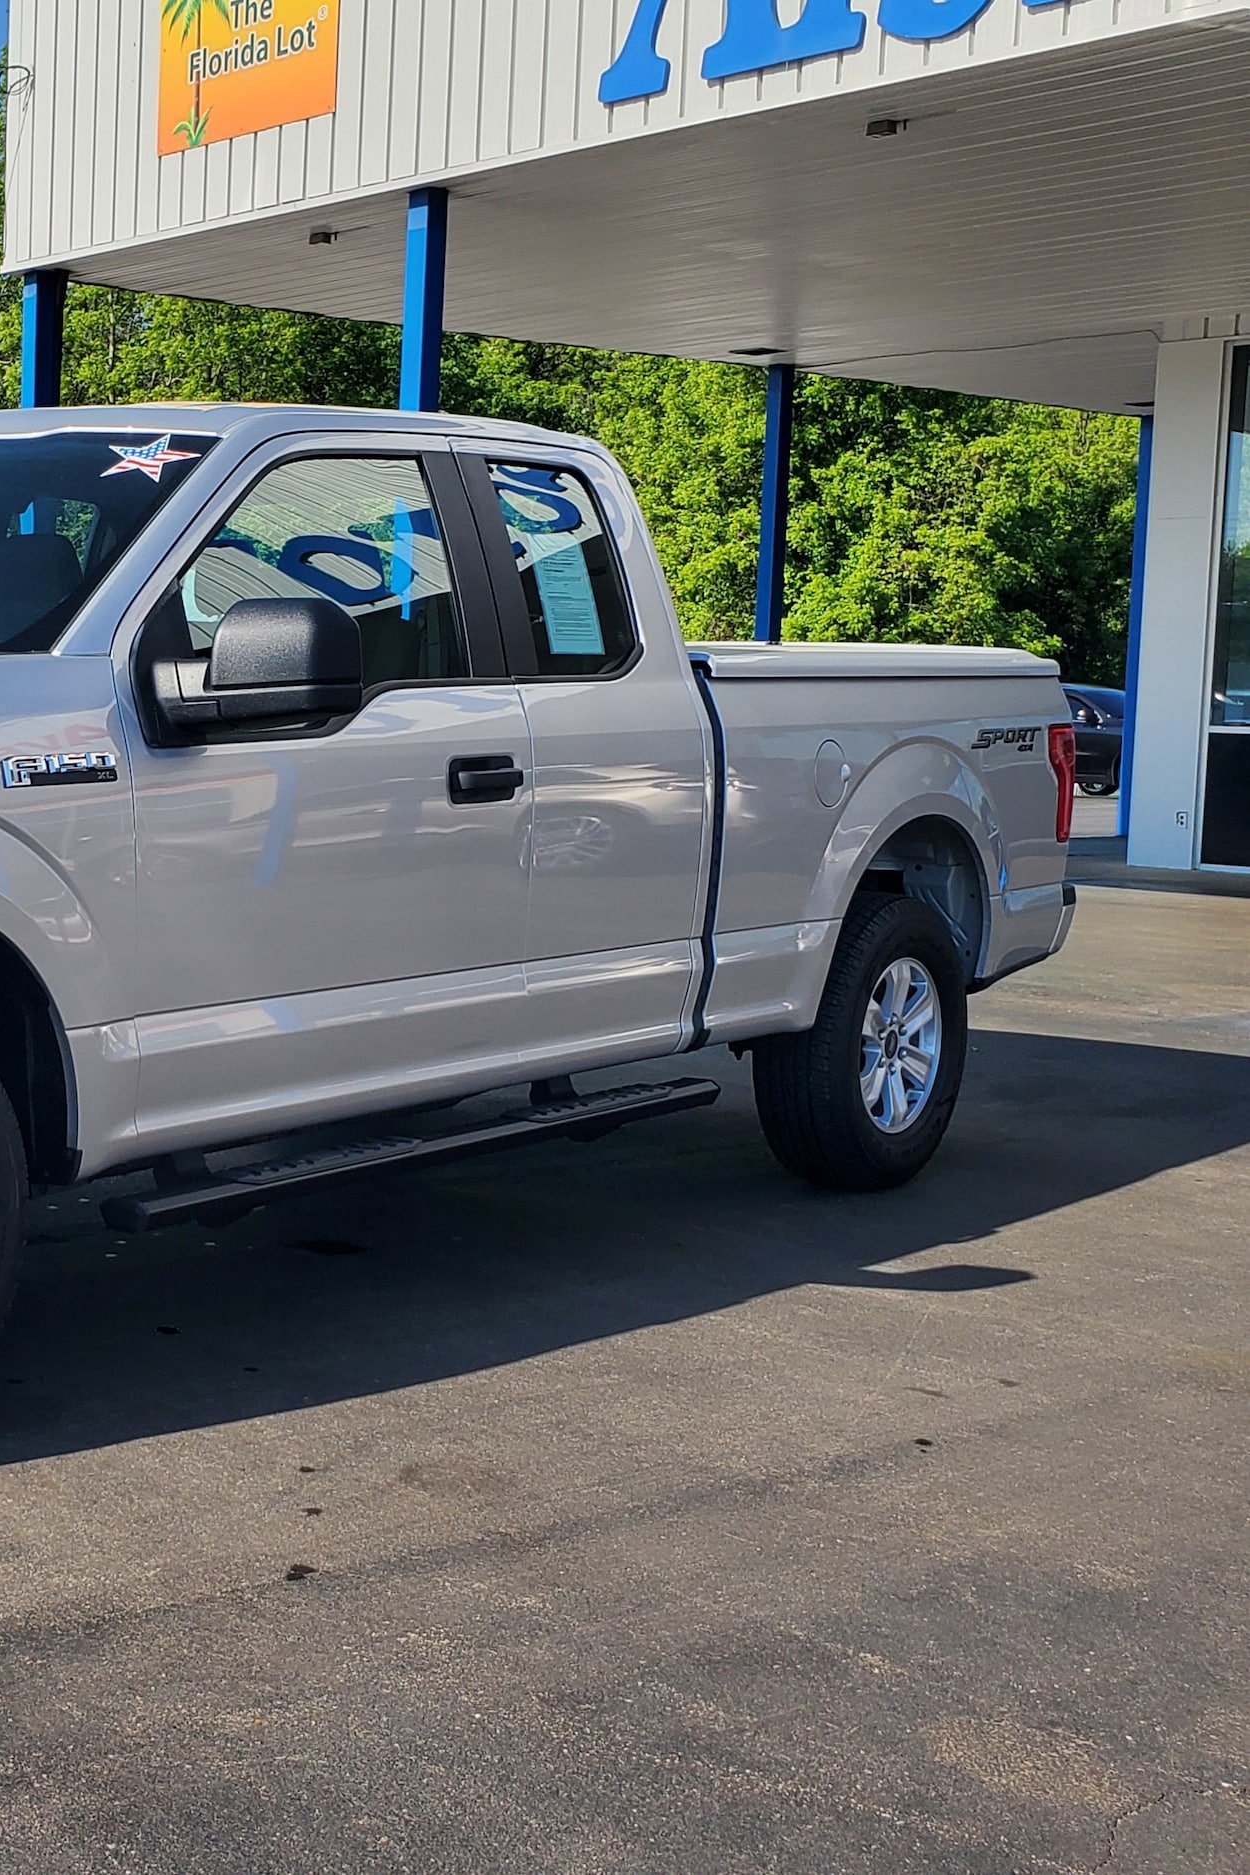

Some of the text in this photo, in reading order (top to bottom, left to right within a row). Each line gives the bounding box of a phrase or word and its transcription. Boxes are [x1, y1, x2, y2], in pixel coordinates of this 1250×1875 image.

[231, 0, 272, 29] The
[190, 20, 316, 82] Florida Lot
[971, 726, 1042, 750] SPORT
[96, 771, 114, 780] XL
